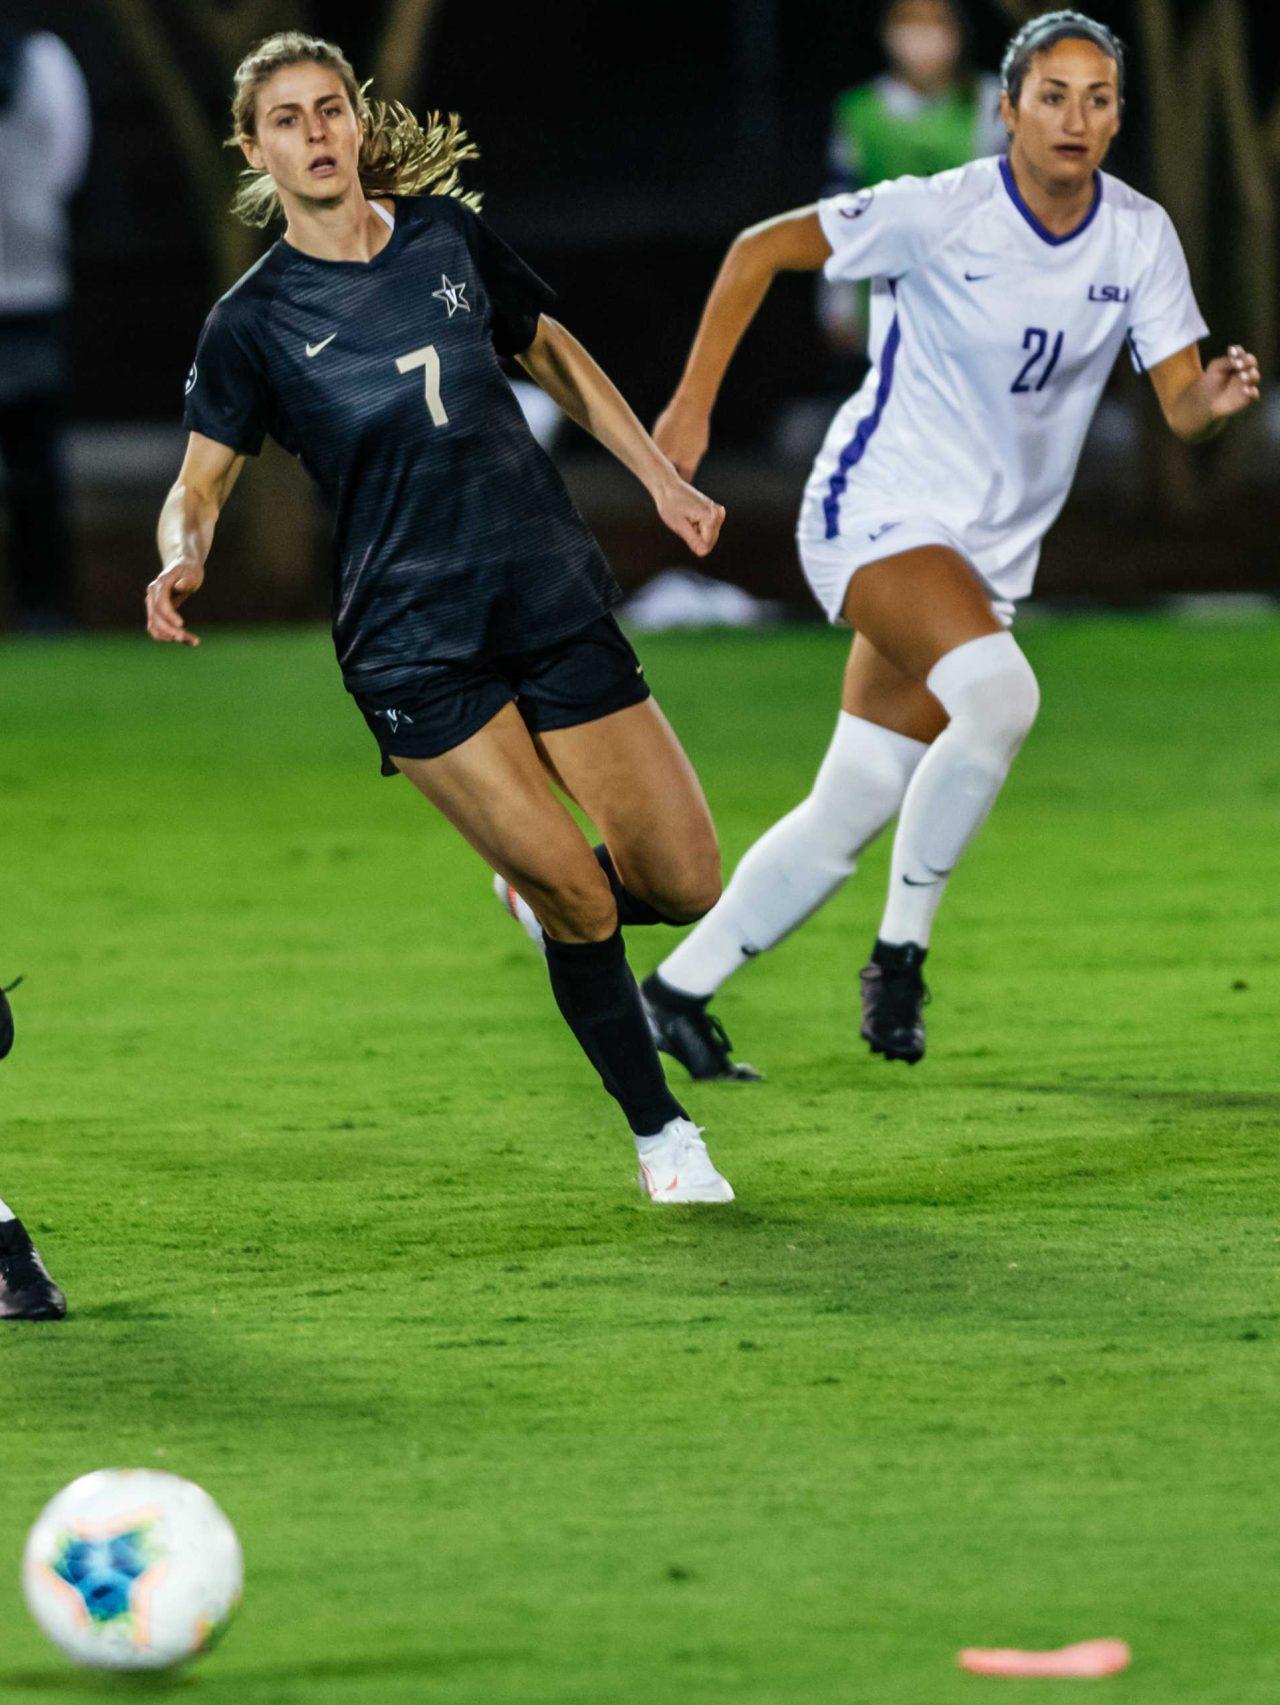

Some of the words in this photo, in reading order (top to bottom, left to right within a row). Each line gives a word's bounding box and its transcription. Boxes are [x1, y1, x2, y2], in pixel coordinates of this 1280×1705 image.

[1088, 284, 1130, 304] LSU
[395, 344, 449, 427] 7
[1010, 327, 1065, 394] 21
